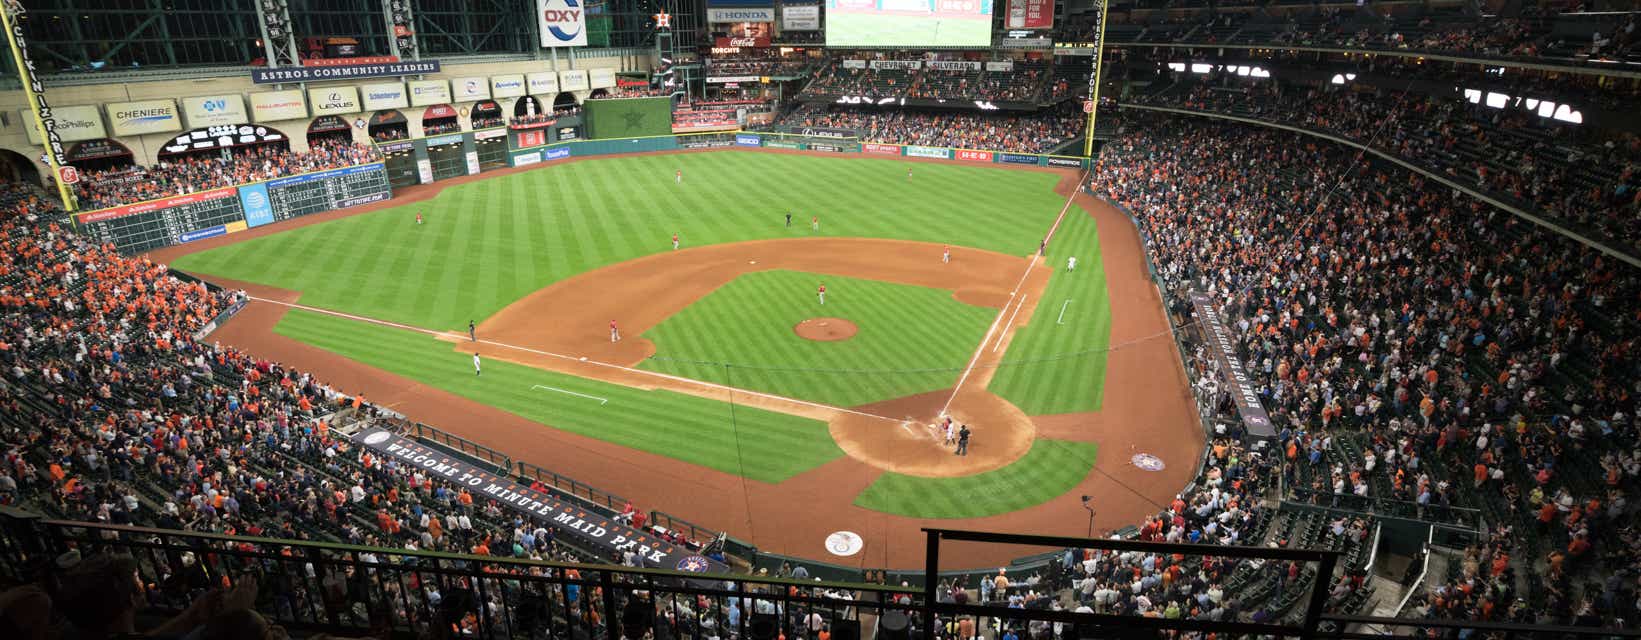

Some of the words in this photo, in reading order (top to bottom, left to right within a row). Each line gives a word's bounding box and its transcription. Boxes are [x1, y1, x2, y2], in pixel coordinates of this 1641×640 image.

[544, 10, 580, 22] OXY
[725, 11, 768, 19] HONDA
[13, 26, 44, 92] CHIKIN
[261, 70, 309, 80] ASTROS
[314, 65, 386, 78] COMMUNITY
[390, 63, 435, 72] LEADERS
[874, 62, 916, 70] CHEVROLET
[319, 102, 354, 110] LEXUS
[116, 108, 172, 119] CHENIERE
[386, 443, 460, 478] WELCOME
[458, 472, 483, 486] TO
[483, 483, 554, 516] MINUTE
[554, 512, 607, 538] MAID
[610, 535, 668, 563] PARK
